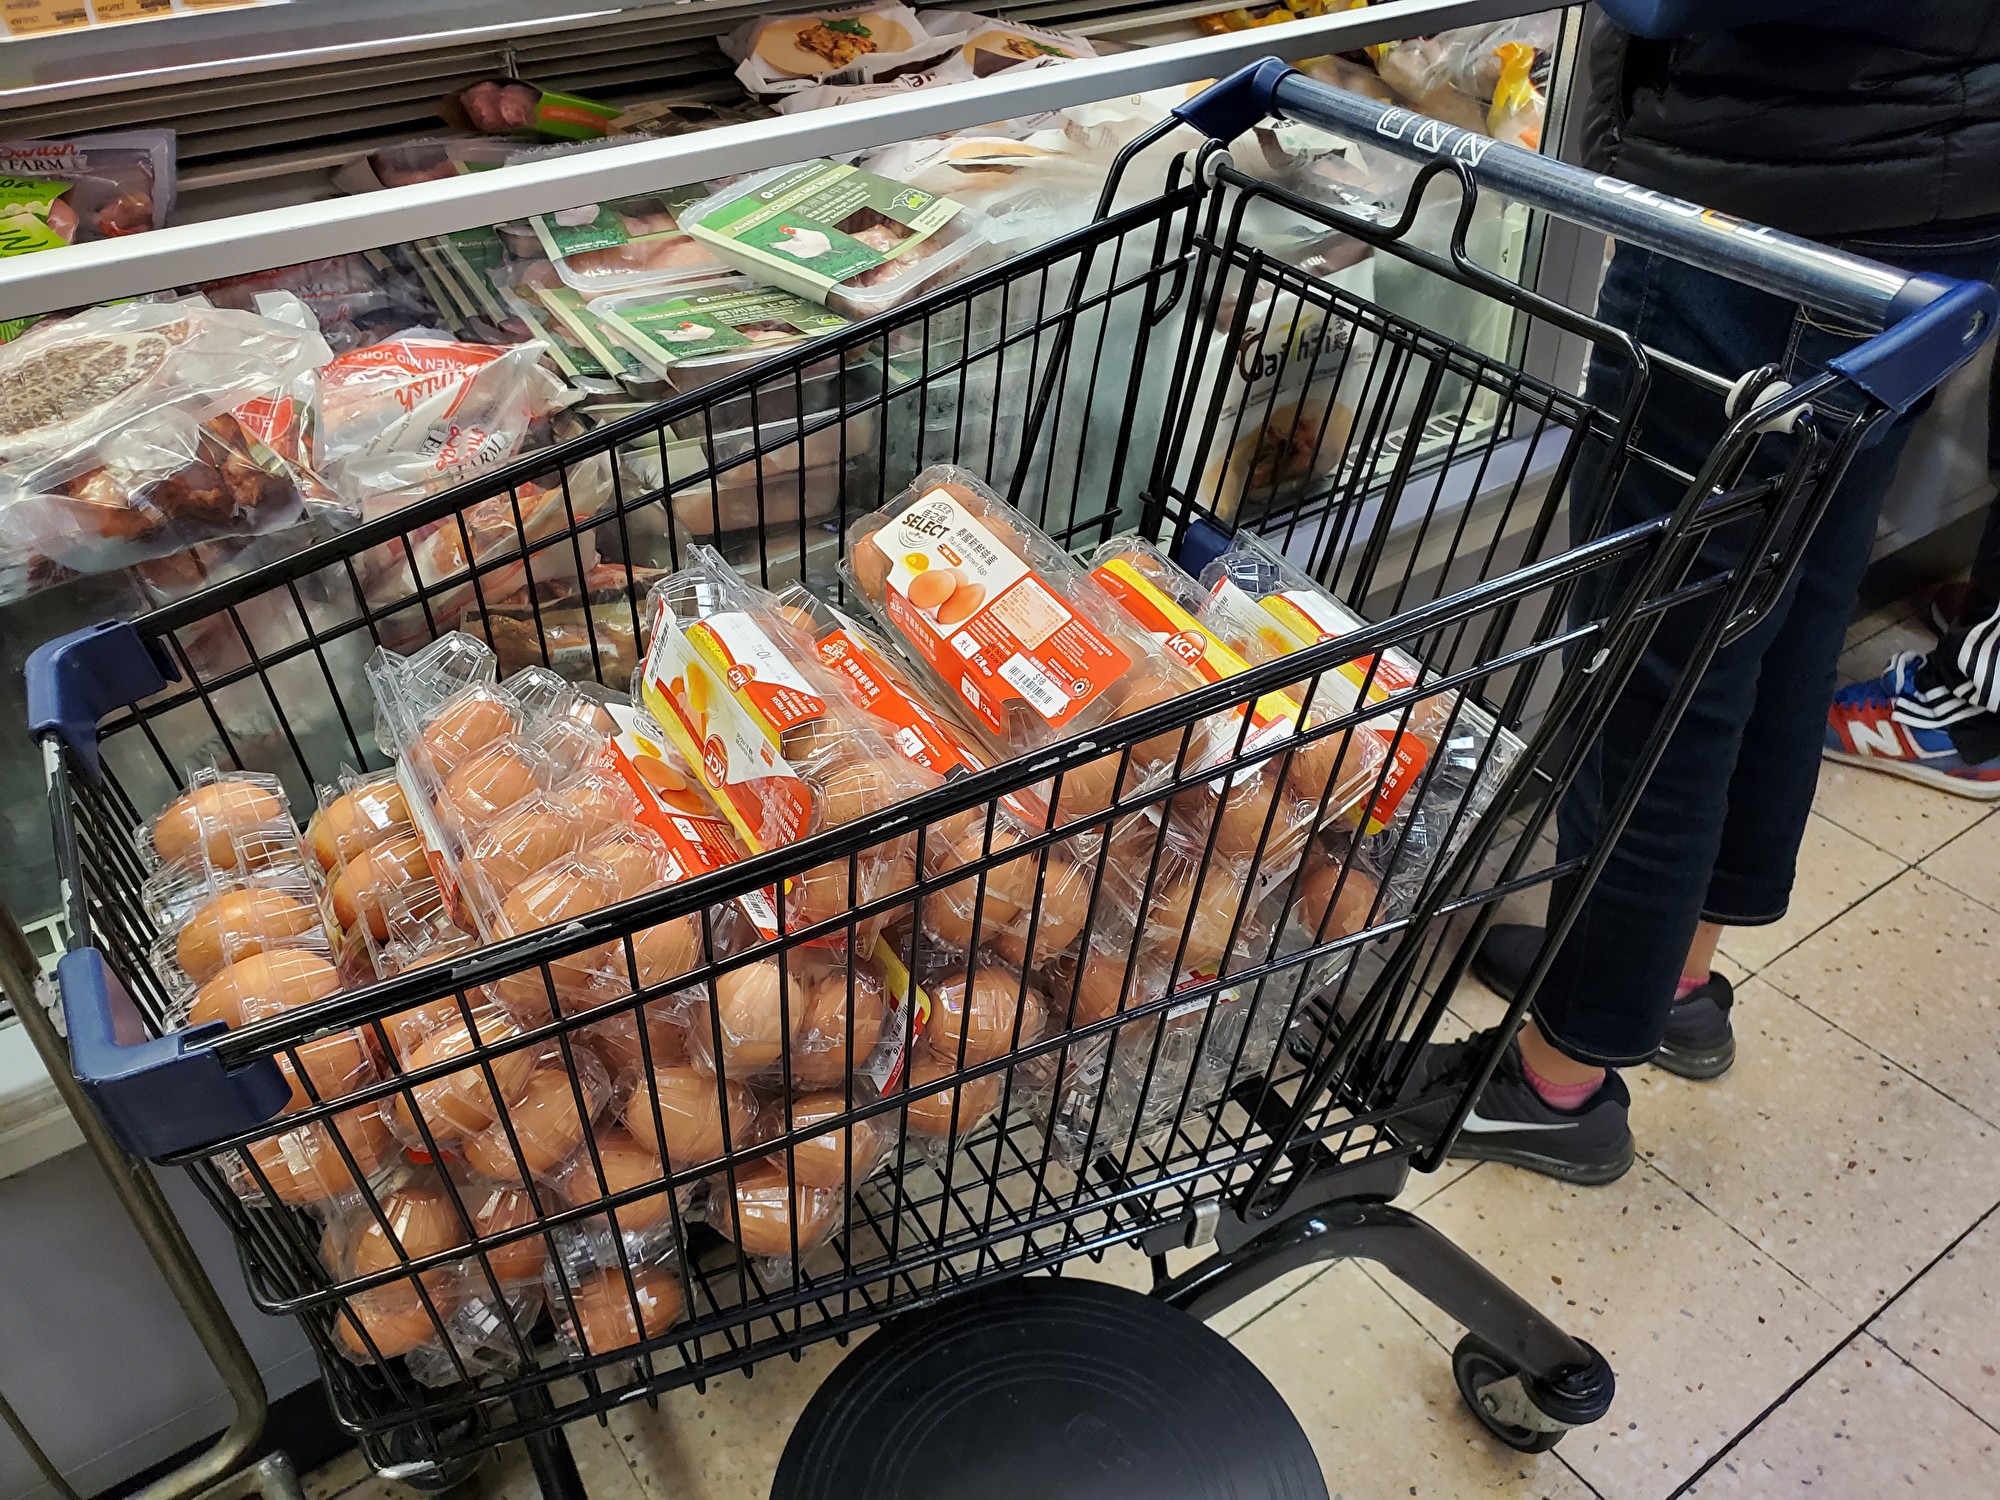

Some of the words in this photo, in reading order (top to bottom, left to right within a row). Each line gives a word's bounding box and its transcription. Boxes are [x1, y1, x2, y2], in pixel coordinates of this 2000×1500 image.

[9, 159, 65, 170] FARM
[902, 513, 950, 539] SELECT
[821, 643, 847, 660] SELECT
[1168, 634, 1201, 660] KCF
[728, 669, 749, 689] KCF
[1032, 673, 1047, 686] $18
[1848, 720, 1905, 757] N
[704, 752, 726, 783] KCF
